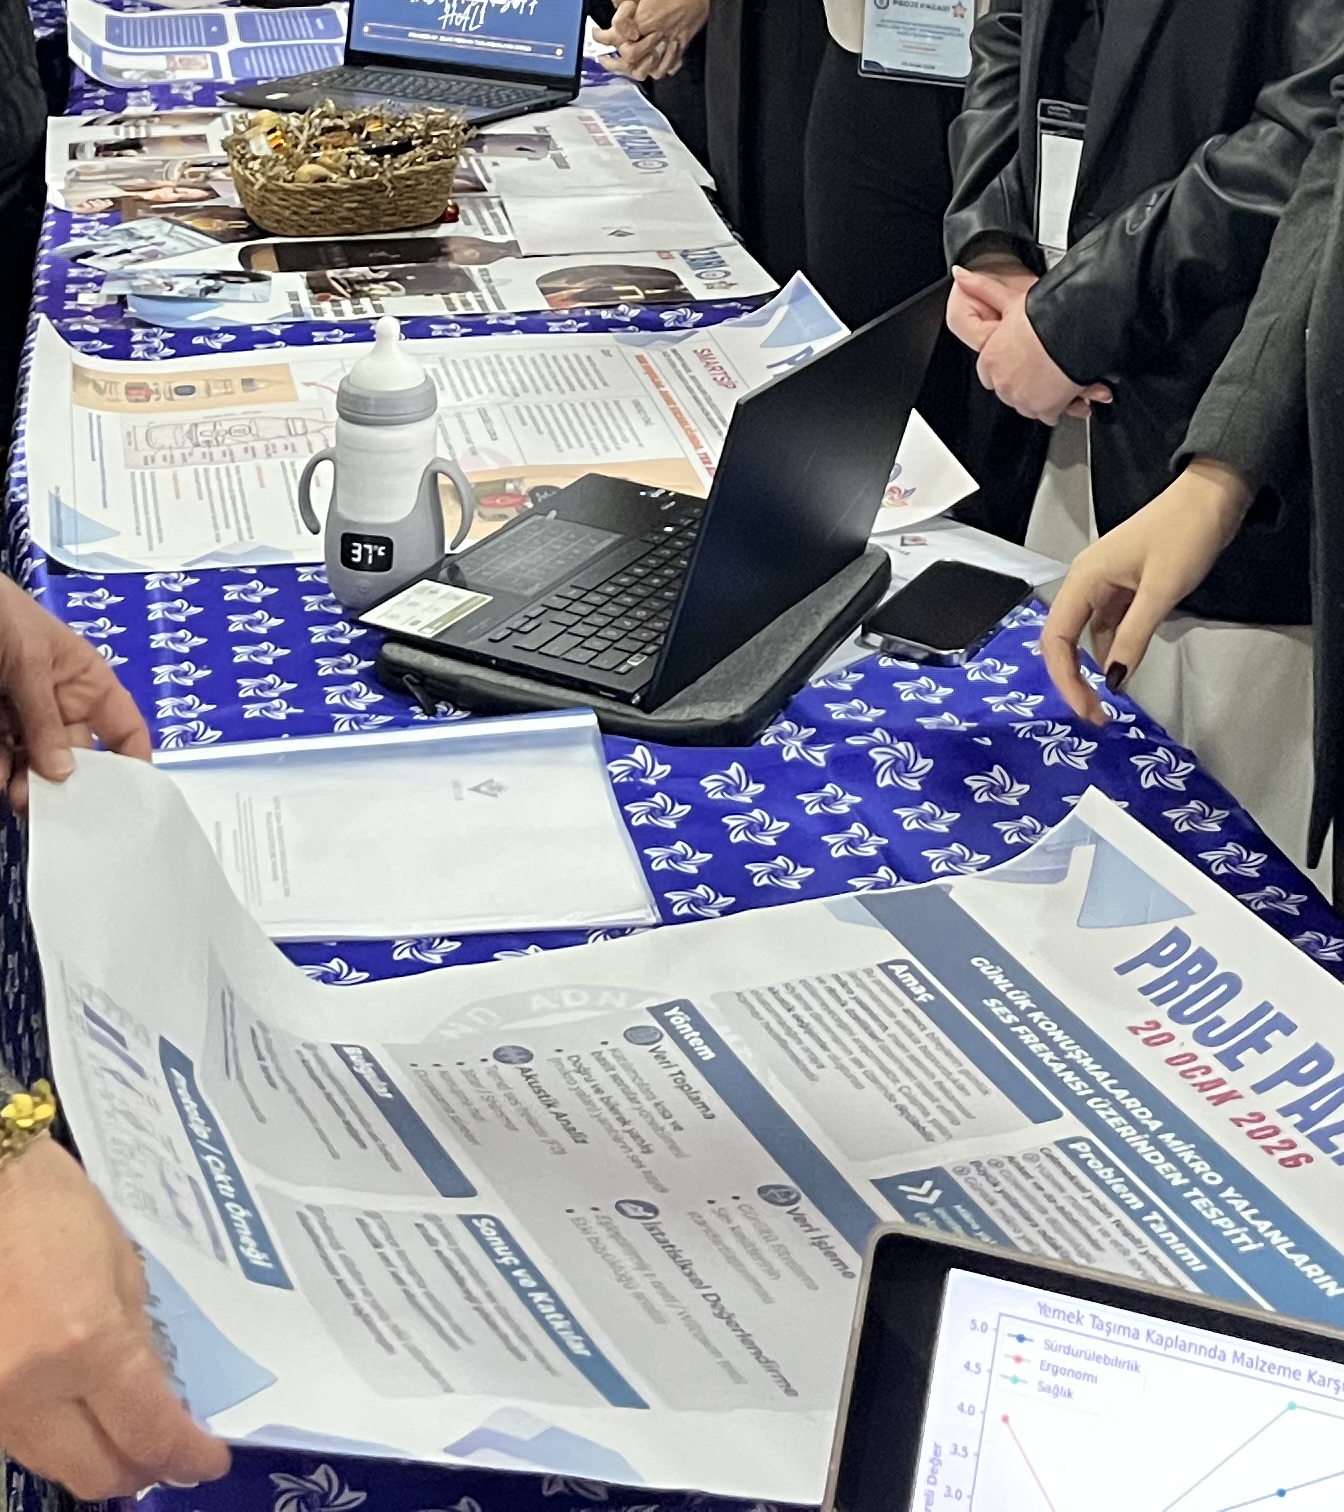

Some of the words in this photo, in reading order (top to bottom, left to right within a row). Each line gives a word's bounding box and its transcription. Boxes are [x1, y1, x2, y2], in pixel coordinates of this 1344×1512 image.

[887, 963, 935, 1003] Amaç
[1114, 927, 1297, 1072] PROJE
[663, 1006, 716, 1062] Yöntem
[517, 1066, 558, 1111] Akustik
[671, 1071, 717, 1120] Toplama
[970, 956, 1037, 1012] GÜNLÜK
[1027, 1009, 1162, 1131] KONUŞMALARDA
[1158, 1132, 1223, 1186] MİKRO
[1127, 1020, 1175, 1048] 20
[1165, 1050, 1244, 1108] OCAK
[1230, 1112, 1314, 1170] 2026
[982, 998, 1019, 1025] SES
[1011, 1022, 1087, 1096] FREKANSI
[1086, 1096, 1189, 1187] ÜZERİNDEN
[1182, 1187, 1265, 1253] TESPİTİ
[1068, 1141, 1144, 1211] Problem
[1142, 1213, 1208, 1273] Tanımı
[471, 1217, 519, 1268] Sonuç
[512, 1269, 537, 1289] ve
[528, 1292, 591, 1358] Katkılar
[969, 1318, 988, 1334] 5.0
[1037, 1301, 1085, 1327] Yemek
[1089, 1313, 1140, 1340] Taşıma
[1145, 1329, 1226, 1362] Kaplarında
[1231, 1350, 1302, 1382] Malzeme
[963, 1360, 982, 1375] 4.5
[1037, 1380, 1074, 1400] Sağlık
[1039, 1359, 1098, 1385] Ergonomi
[956, 1402, 976, 1416] 4.0
